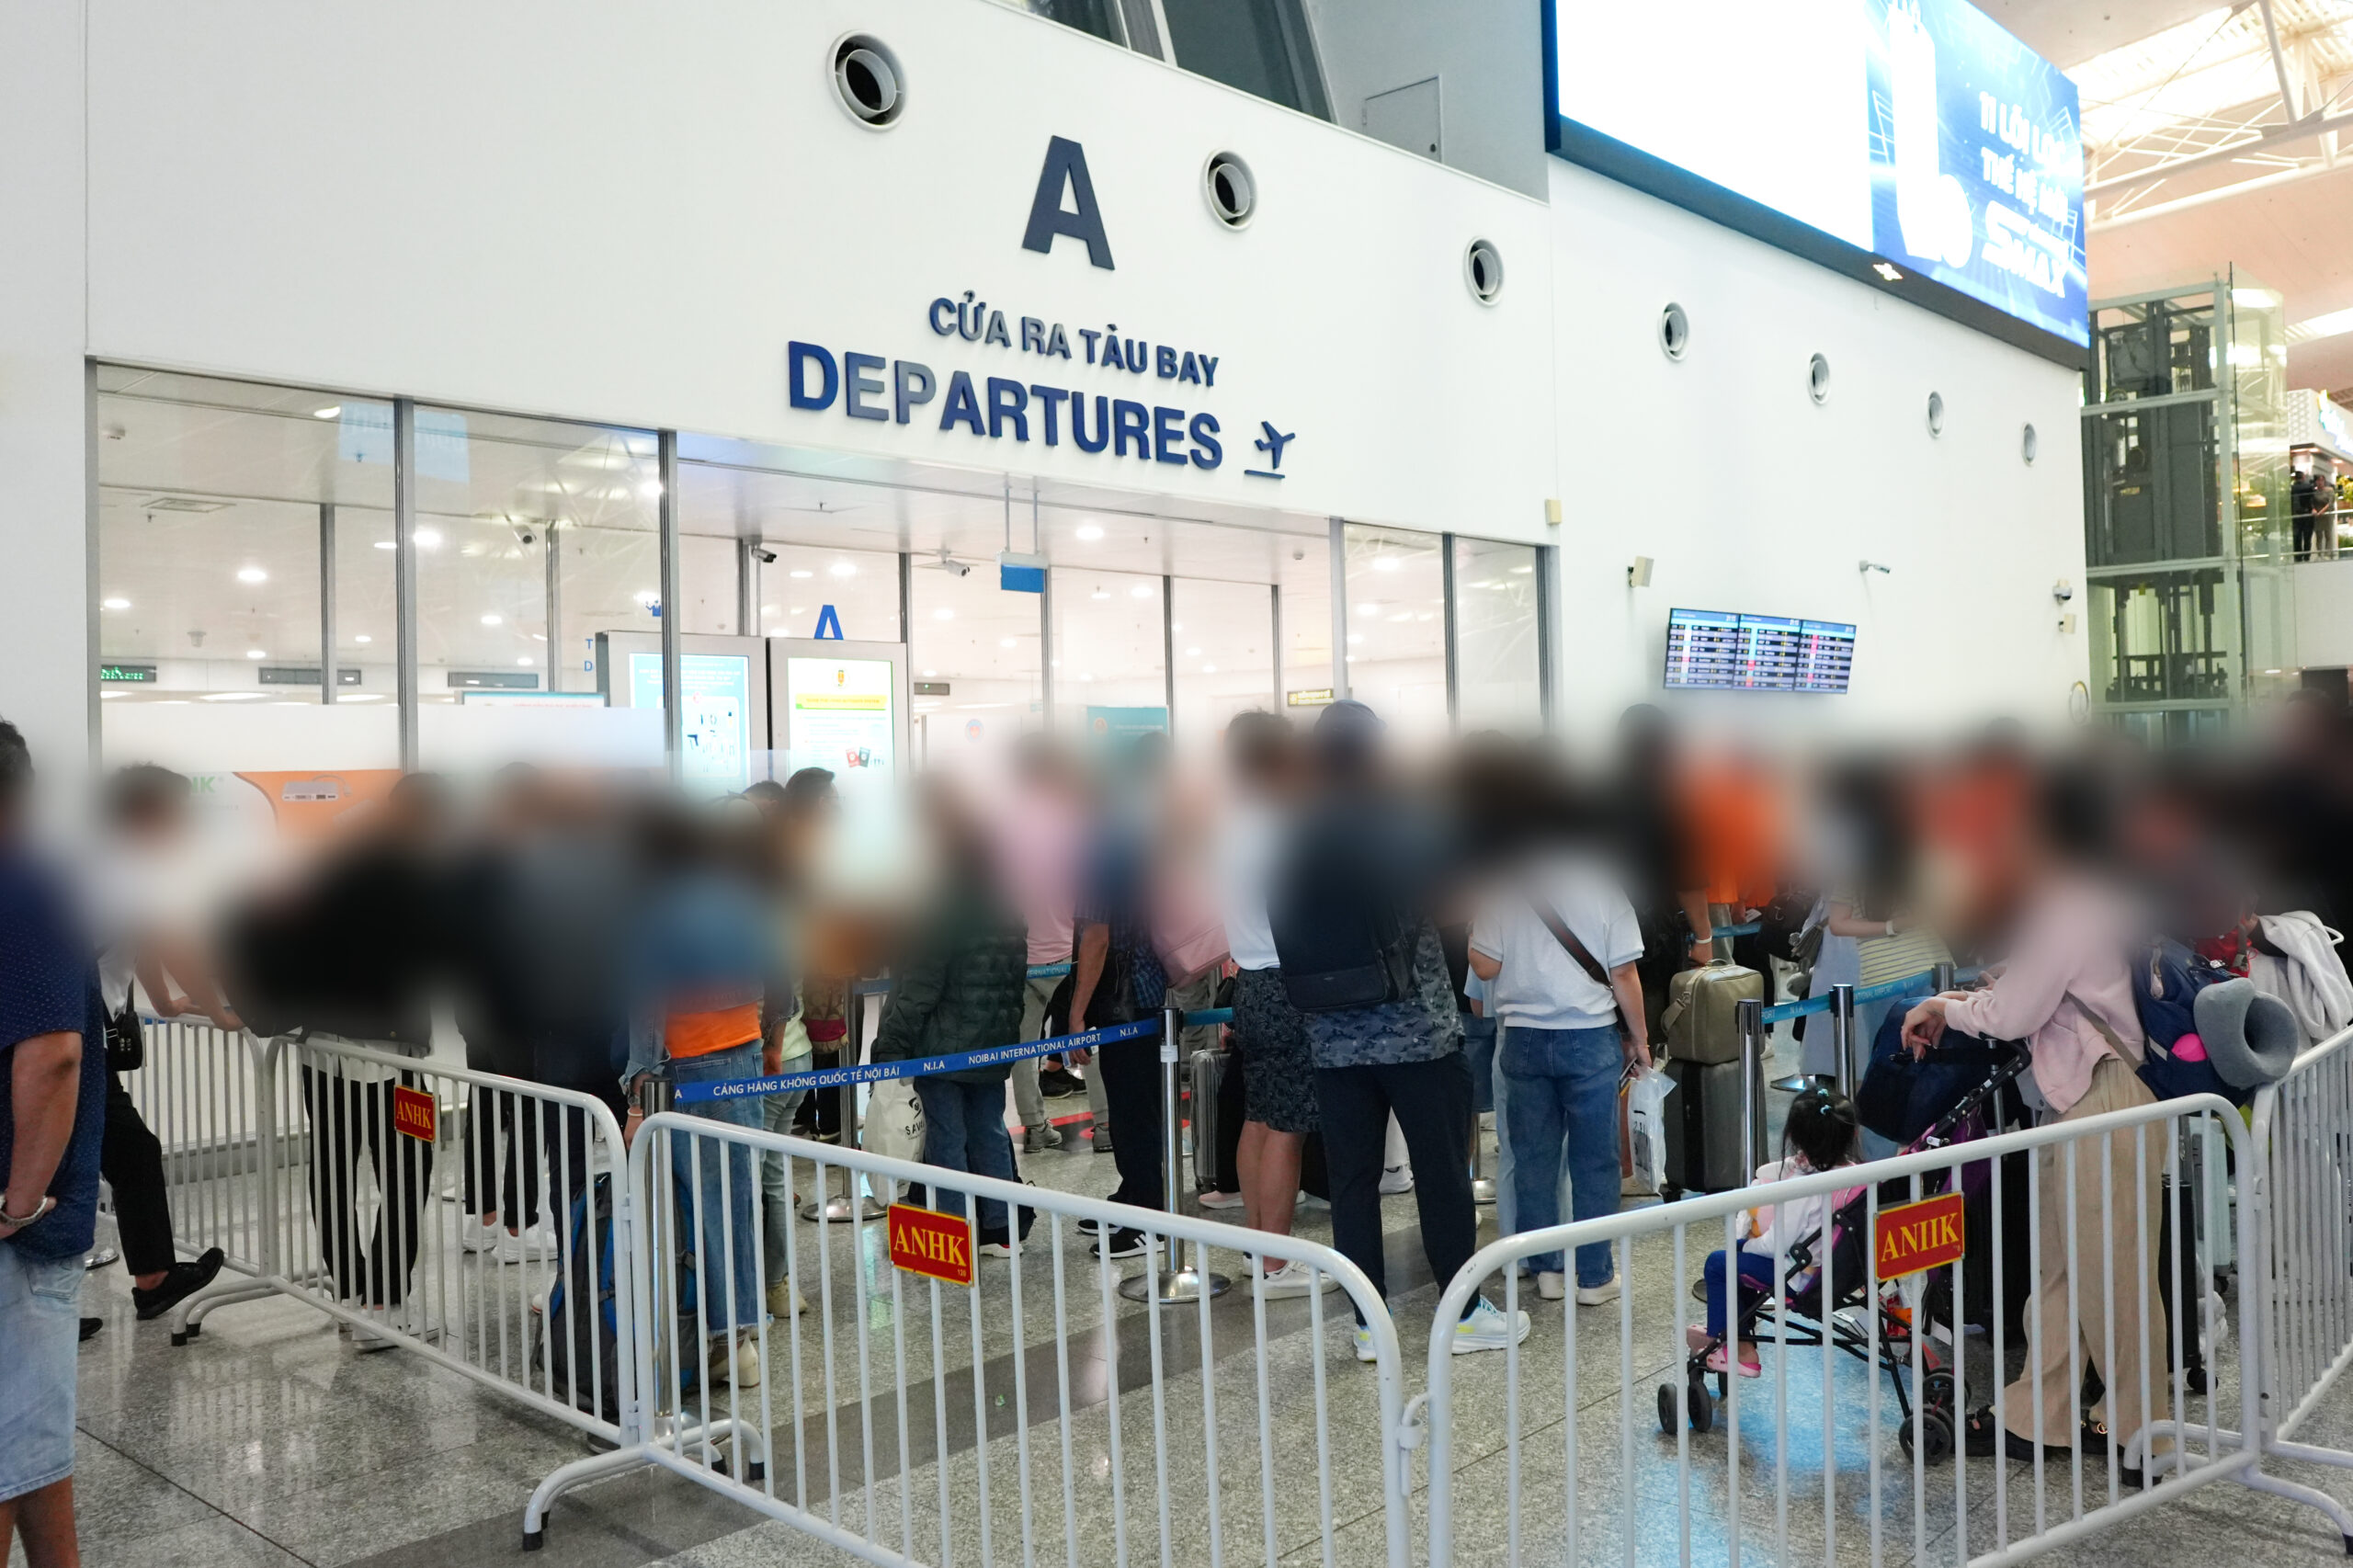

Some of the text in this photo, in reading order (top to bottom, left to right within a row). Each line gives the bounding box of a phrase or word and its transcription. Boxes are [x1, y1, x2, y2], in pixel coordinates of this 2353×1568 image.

[1021, 135, 1115, 270] A
[929, 290, 1219, 387] CỬA RA TÀU BAY
[788, 340, 1223, 470] DEPARTURES
[968, 1032, 1101, 1065] NOIBAI INTERNATIONAL AIRPORT
[1120, 1026, 1139, 1038] N.I.A
[713, 1083, 745, 1096] CẢNG
[780, 1076, 816, 1089] KHÔNG
[819, 1069, 847, 1085] QUỐC
[850, 1067, 863, 1081] TẾ
[864, 1066, 881, 1081] NỘI
[923, 1060, 946, 1072] N.I.A
[396, 1099, 432, 1131] ANHK
[893, 1222, 967, 1267] ANHK
